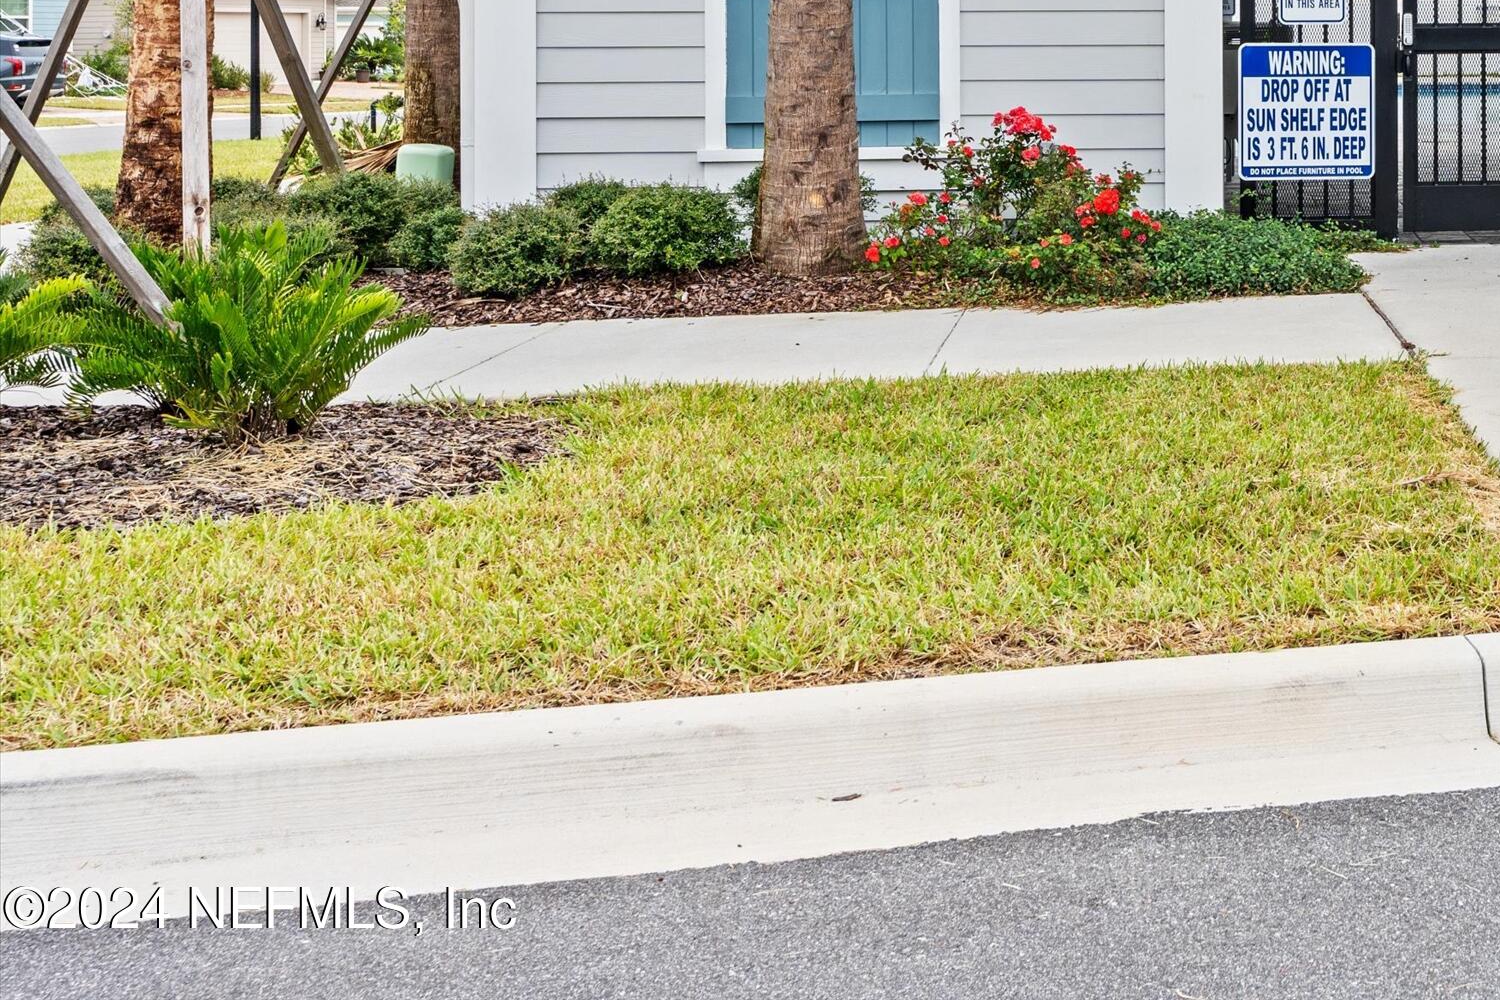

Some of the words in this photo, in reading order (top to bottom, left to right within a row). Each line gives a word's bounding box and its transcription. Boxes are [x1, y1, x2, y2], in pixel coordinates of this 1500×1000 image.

[1285, 0, 1293, 9] IN
[1297, 0, 1315, 9] THIS
[1319, 0, 1340, 9] AREA
[1268, 50, 1345, 75] WARNING:
[1261, 79, 1299, 102] DROP
[1304, 79, 1330, 102] OFF
[1334, 79, 1352, 102] AT
[1247, 108, 1276, 132] SUN
[1281, 108, 1325, 132] SHELF
[1330, 108, 1367, 131] EDGE
[1248, 137, 1260, 160] IS
[1267, 137, 1275, 160] 3
[1280, 137, 1297, 160] FT.
[1301, 137, 1309, 160] 6
[1313, 136, 1329, 160] IN.
[1334, 136, 1365, 160] DEEP
